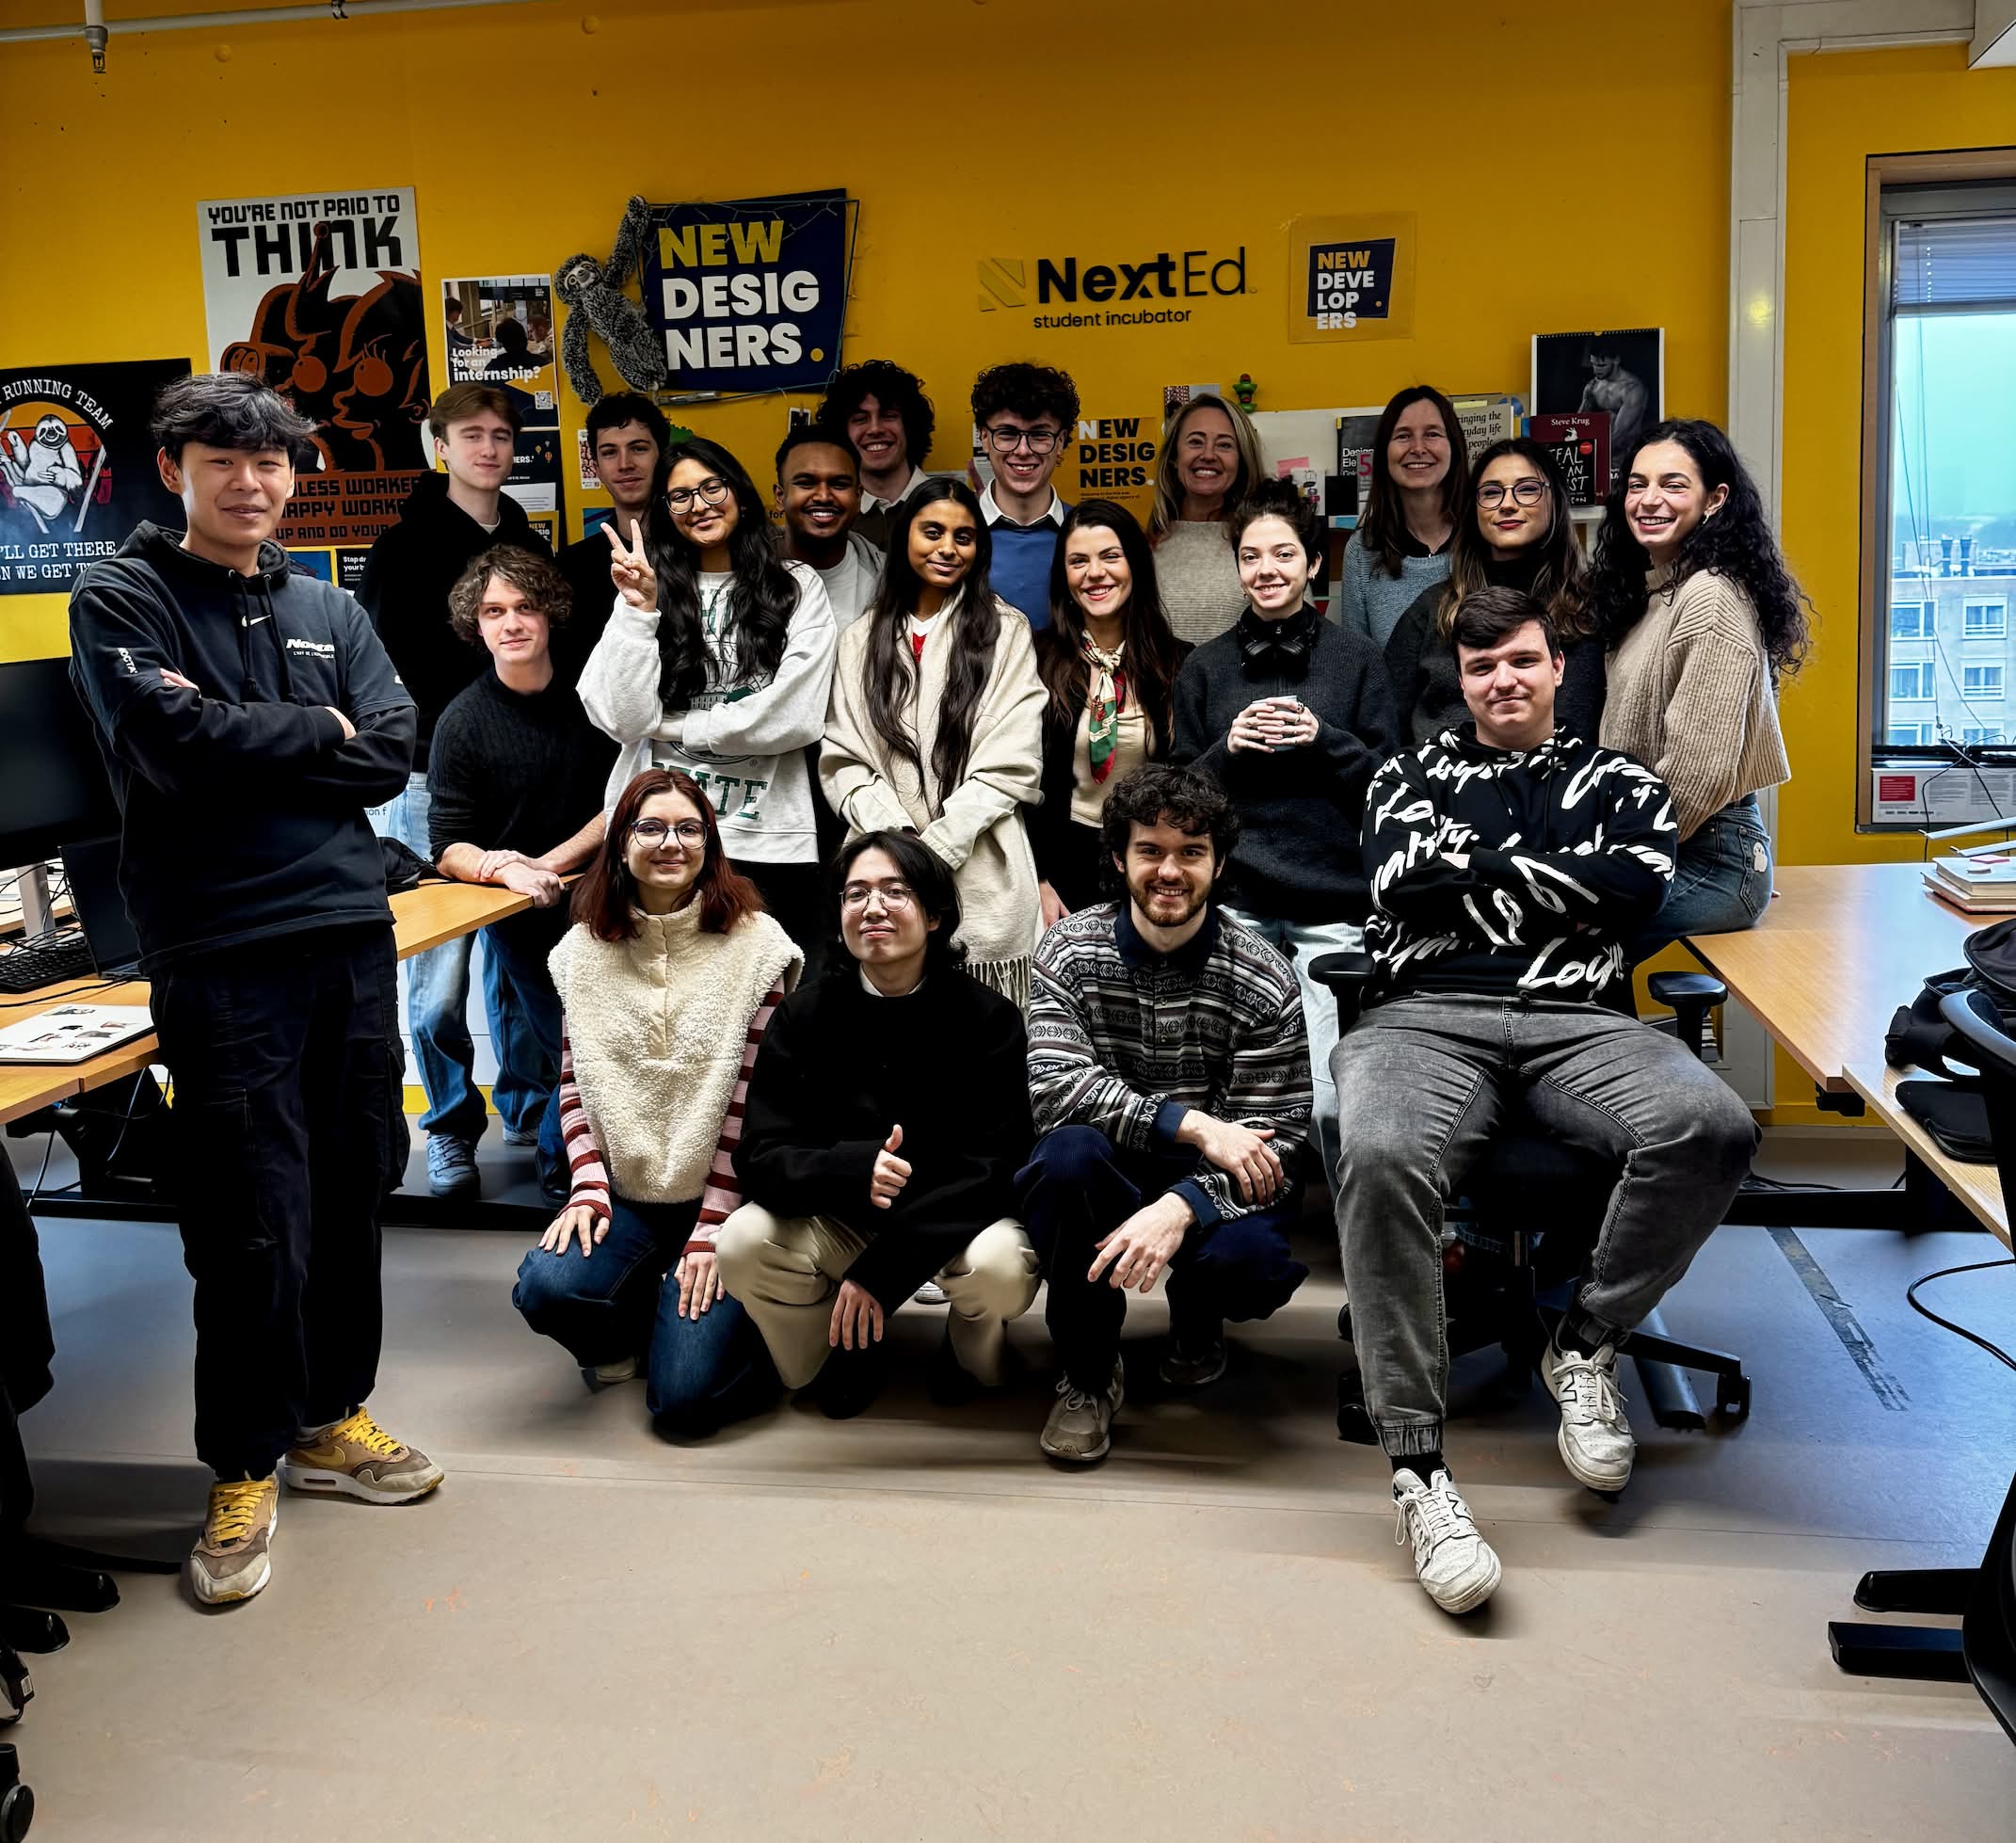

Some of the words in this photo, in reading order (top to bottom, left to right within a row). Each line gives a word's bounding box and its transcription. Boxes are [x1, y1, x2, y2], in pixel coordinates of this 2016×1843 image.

[208, 203, 276, 224] YOU'RE
[280, 200, 320, 219] NOT
[324, 197, 369, 216] PAID
[373, 195, 400, 214] TO
[211, 216, 403, 277] THINK
[658, 220, 784, 270] NEW
[1318, 250, 1370, 269] NEW
[1318, 270, 1374, 290] DEVE
[663, 270, 820, 320] DESIG
[1318, 292, 1360, 310] LOP
[1033, 312, 1101, 329] student
[1106, 309, 1192, 326] incubator
[1318, 312, 1357, 329] ERS
[452, 346, 498, 359] Looking
[452, 358, 467, 368] for
[454, 365, 542, 383] internship?
[2, 378, 72, 400] RUNNING
[75, 390, 114, 430] TEAM
[1489, 410, 1502, 421] the
[1572, 417, 1591, 426] Krug
[1078, 418, 1141, 441] NEW
[1489, 423, 1502, 435] life
[1080, 441, 1156, 464] DESIG
[1080, 466, 1155, 489] NERS.
[283, 500, 336, 518] APPY
[276, 527, 294, 539] UP
[297, 524, 326, 539] AND
[330, 525, 348, 537] DO
[28, 543, 59, 558] GET
[63, 540, 117, 557] THERE
[15, 565, 37, 580] WE
[41, 563, 72, 579] GET
